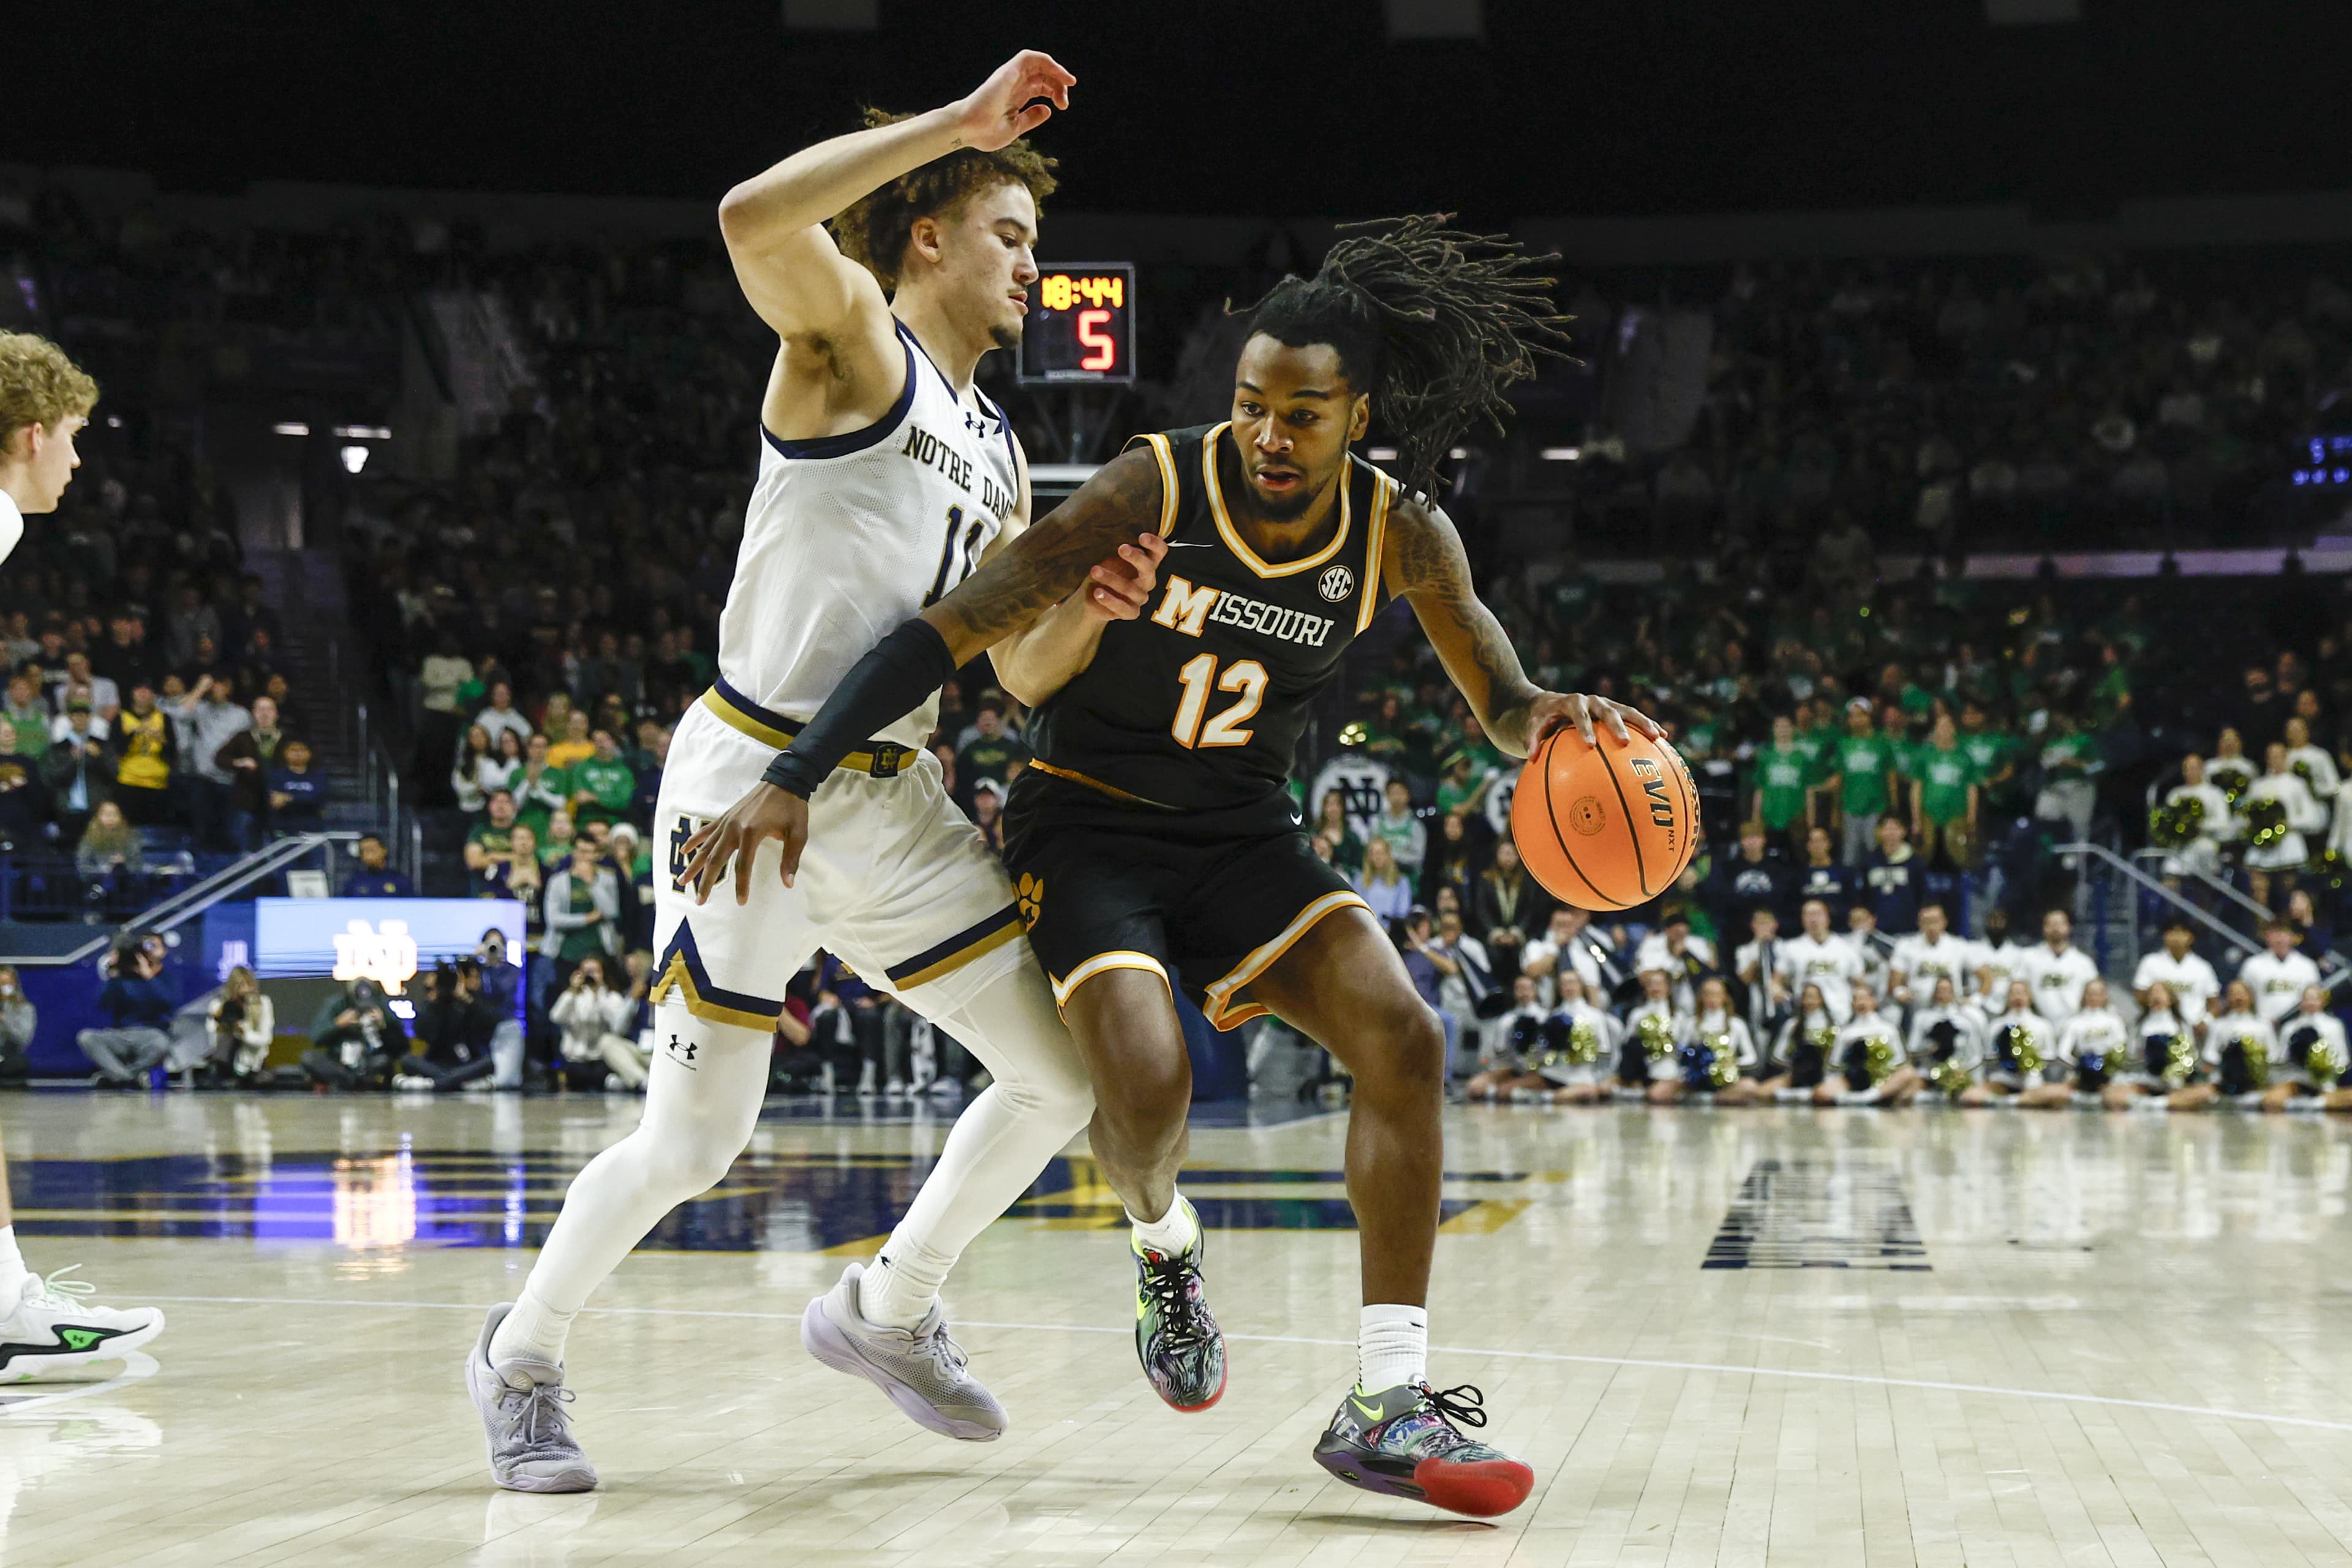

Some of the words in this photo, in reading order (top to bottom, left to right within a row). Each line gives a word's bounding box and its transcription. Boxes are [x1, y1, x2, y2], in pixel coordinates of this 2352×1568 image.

[1042, 275, 1123, 310] 18:44
[1079, 310, 1114, 371] 5
[903, 425, 973, 493] NOTRE
[1151, 574, 1334, 647] MISSOURI
[1321, 565, 1352, 600] SEC
[1172, 652, 1269, 749] 12
[1630, 758, 1673, 827] EVO
